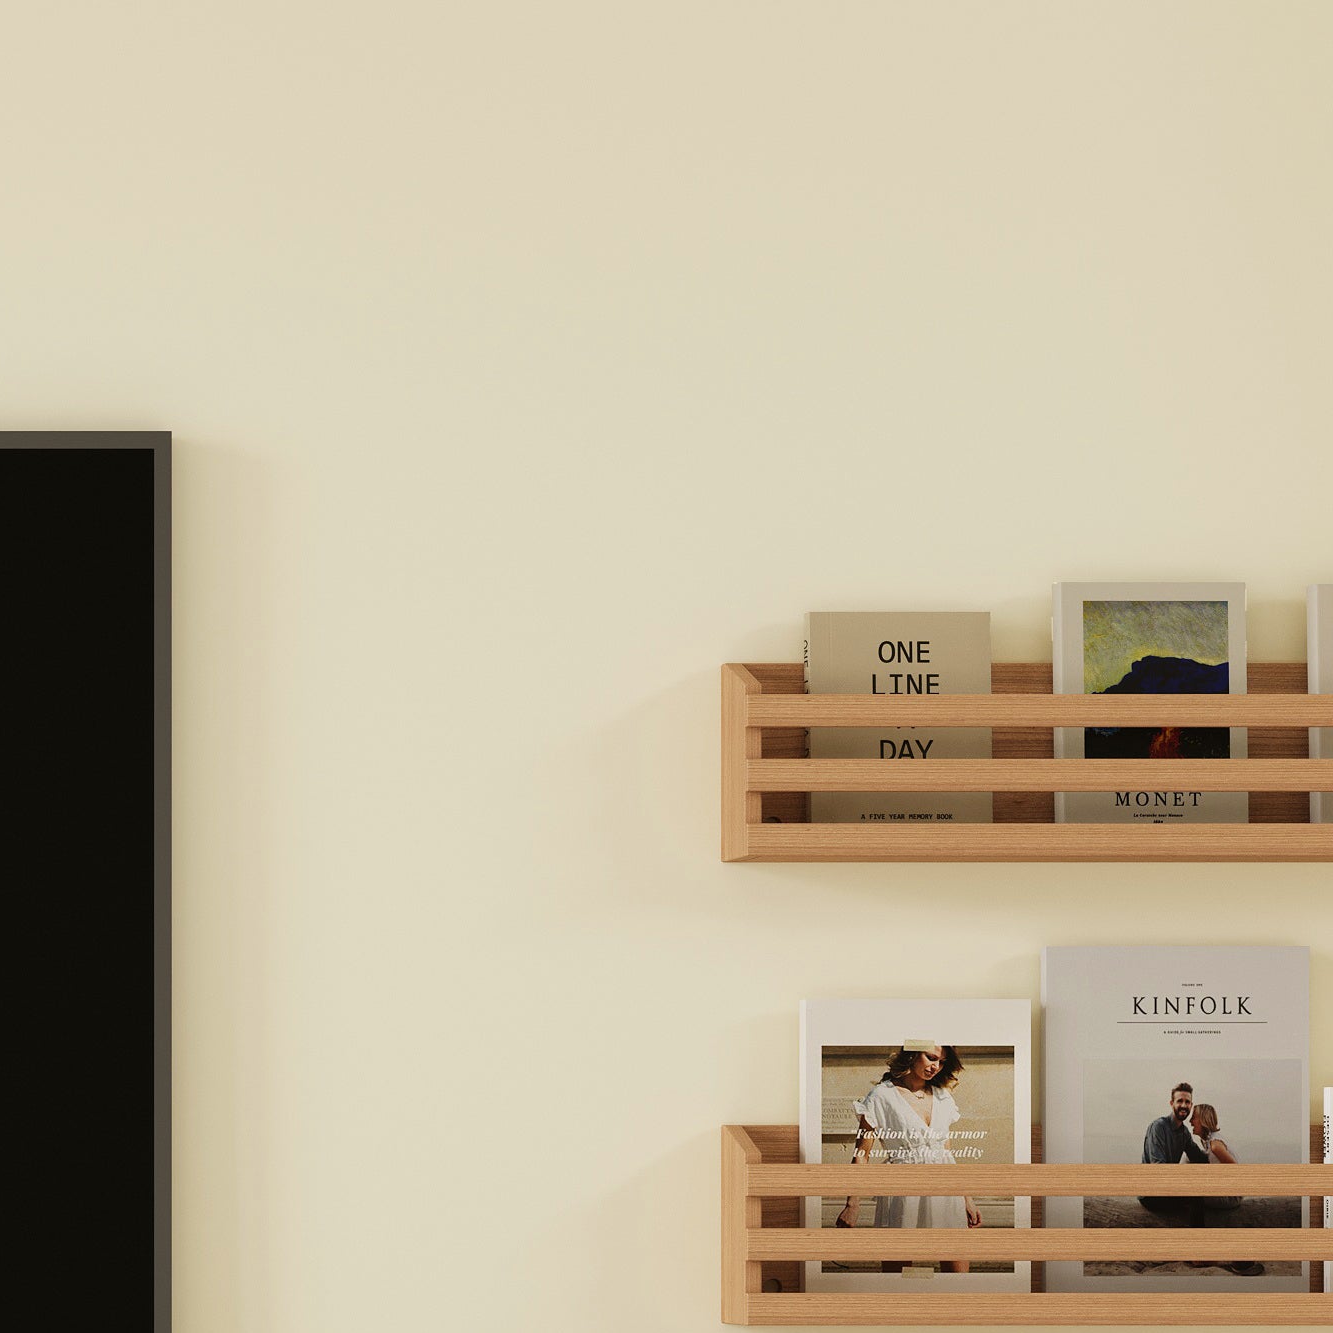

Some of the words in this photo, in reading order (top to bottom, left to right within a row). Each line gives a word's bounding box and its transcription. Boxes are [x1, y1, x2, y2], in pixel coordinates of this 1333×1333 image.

[878, 641, 930, 663] ONE
[872, 674, 939, 694] LINE
[879, 739, 933, 759] DAY
[1115, 791, 1202, 807] MONET
[1133, 996, 1252, 1015] KINFOLK
[946, 1130, 988, 1140] armor
[853, 1147, 865, 1158] to
[869, 1147, 916, 1158] survive
[943, 1146, 984, 1160] reality
